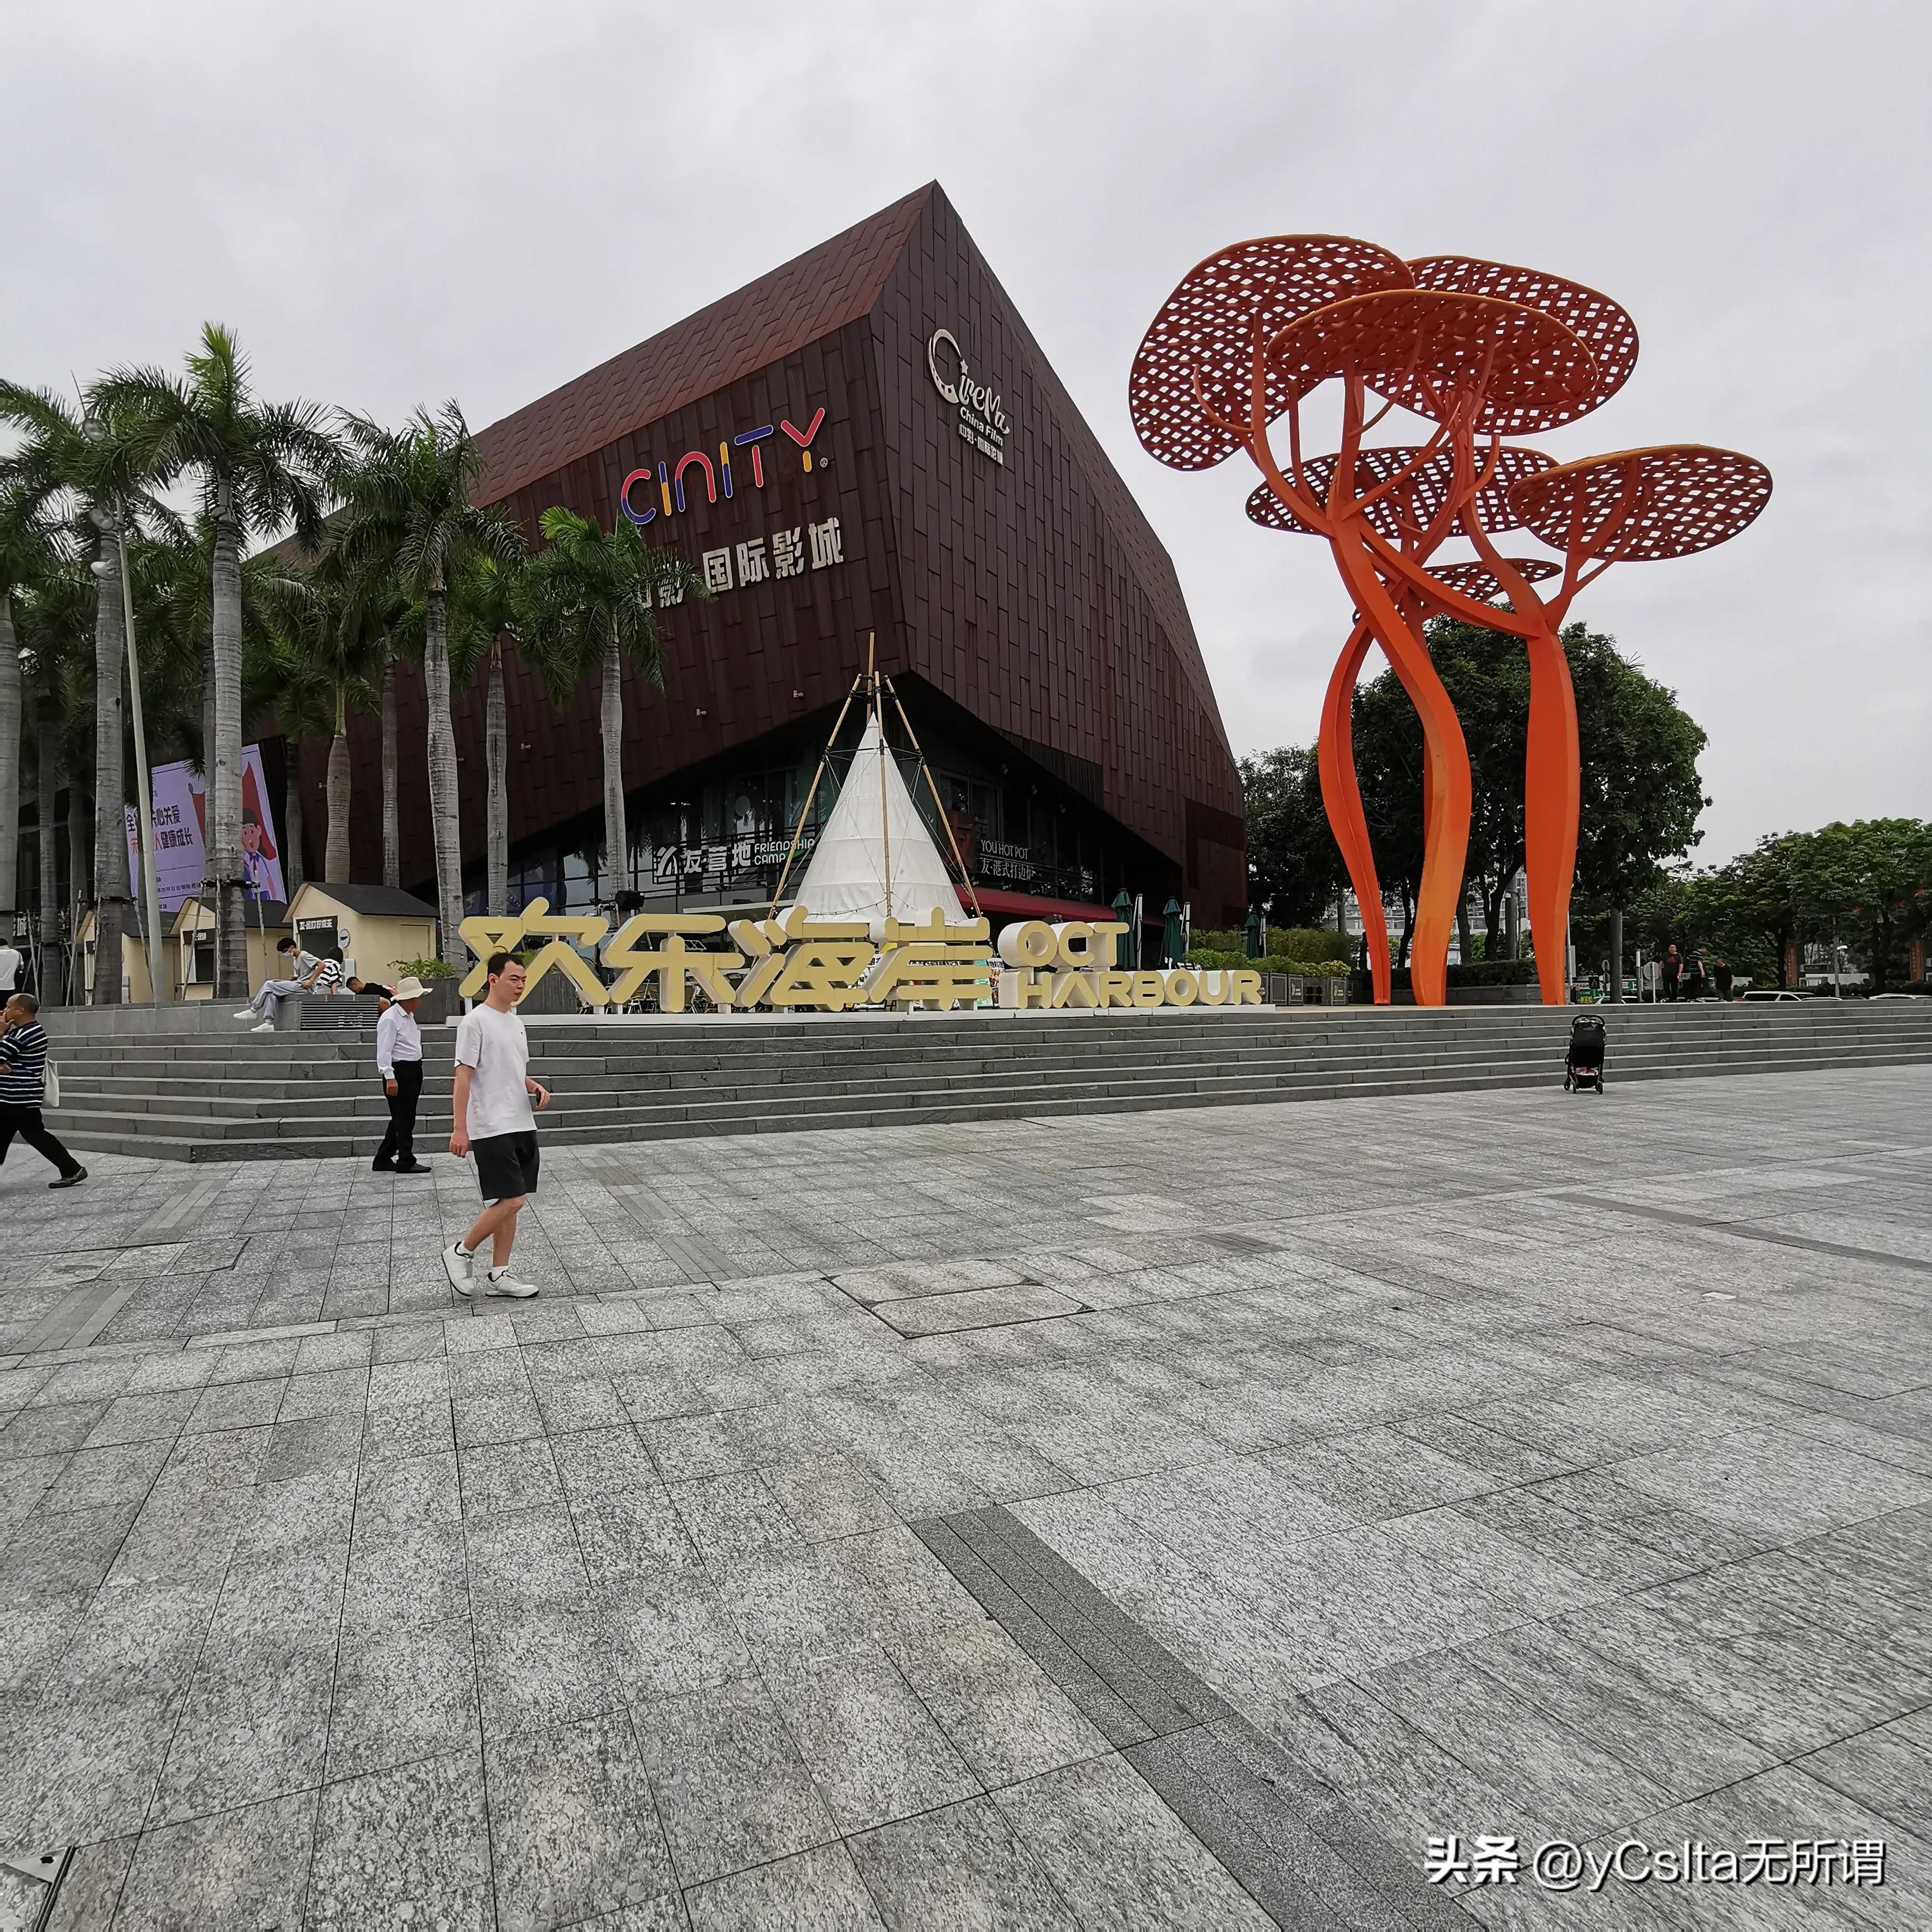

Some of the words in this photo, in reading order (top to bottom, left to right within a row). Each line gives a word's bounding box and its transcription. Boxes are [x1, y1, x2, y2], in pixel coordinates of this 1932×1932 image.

[960, 406, 984, 433] China
[986, 424, 1003, 447] Film
[702, 517, 845, 594] 国际影城
[754, 853, 786, 865] CAMP
[981, 839, 997, 854] YOU
[998, 843, 1014, 857] HOT
[1015, 846, 1030, 860] POT
[458, 896, 993, 1012] 欢乐海岸
[1014, 920, 1129, 968] OCT
[1016, 969, 1263, 1010] HARBOUR
